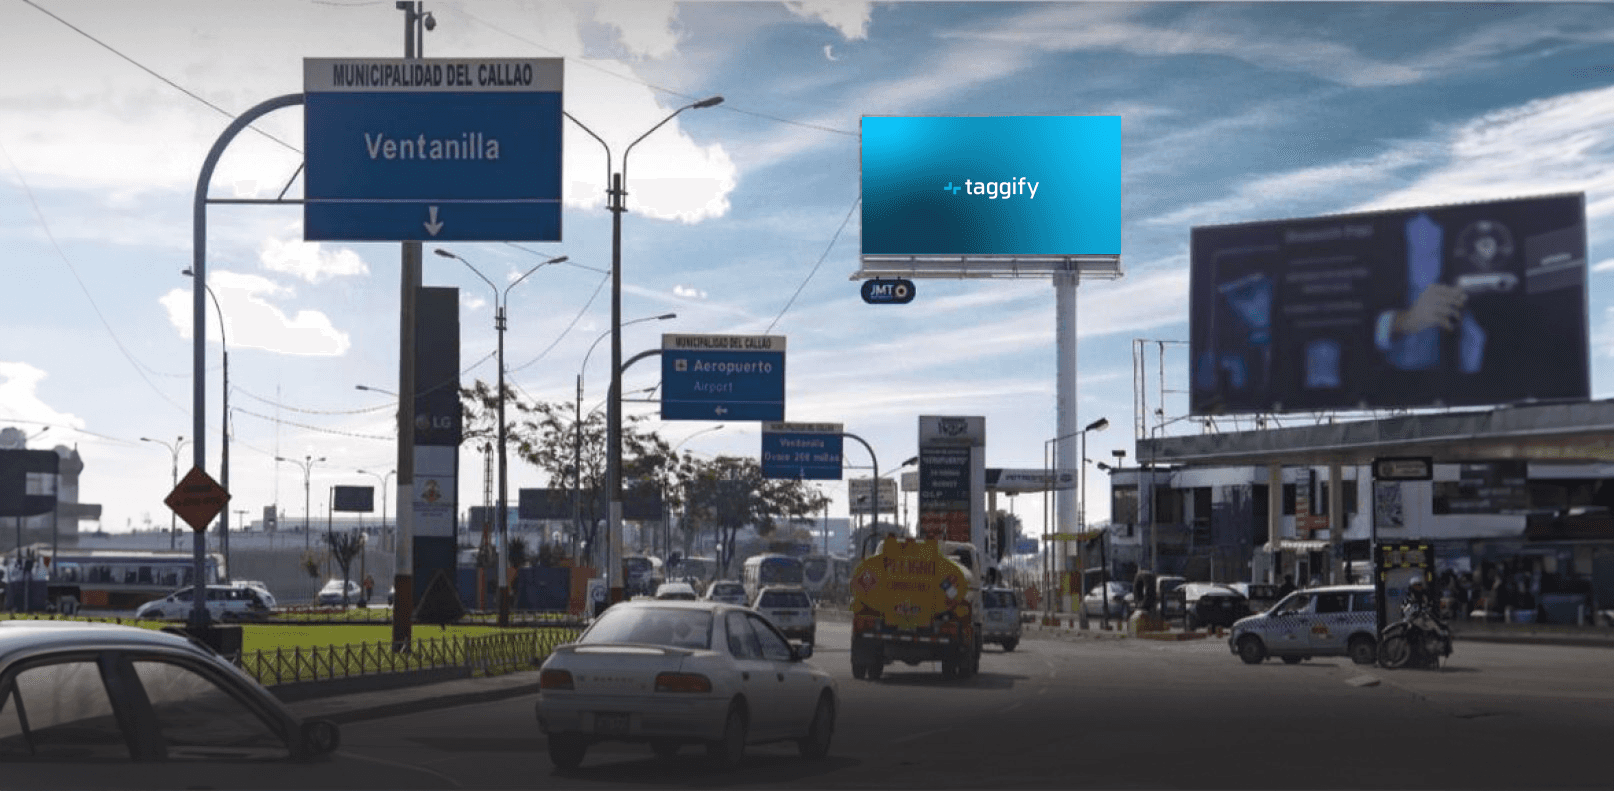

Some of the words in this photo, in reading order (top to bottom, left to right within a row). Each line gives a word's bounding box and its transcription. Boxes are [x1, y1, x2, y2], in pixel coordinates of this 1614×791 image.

[333, 63, 442, 87] MUNICIPALIDAD
[446, 64, 473, 86] DEL
[478, 63, 533, 86] CALLAO
[364, 132, 500, 160] Ventanilla
[964, 176, 1040, 200] taggify
[675, 336, 729, 349] MUNICIPALIDAD
[730, 337, 743, 349] DEL
[745, 337, 772, 349] CALLAO
[694, 359, 773, 376] Aeropuerto
[693, 381, 733, 394] Airport
[433, 415, 452, 429] LG
